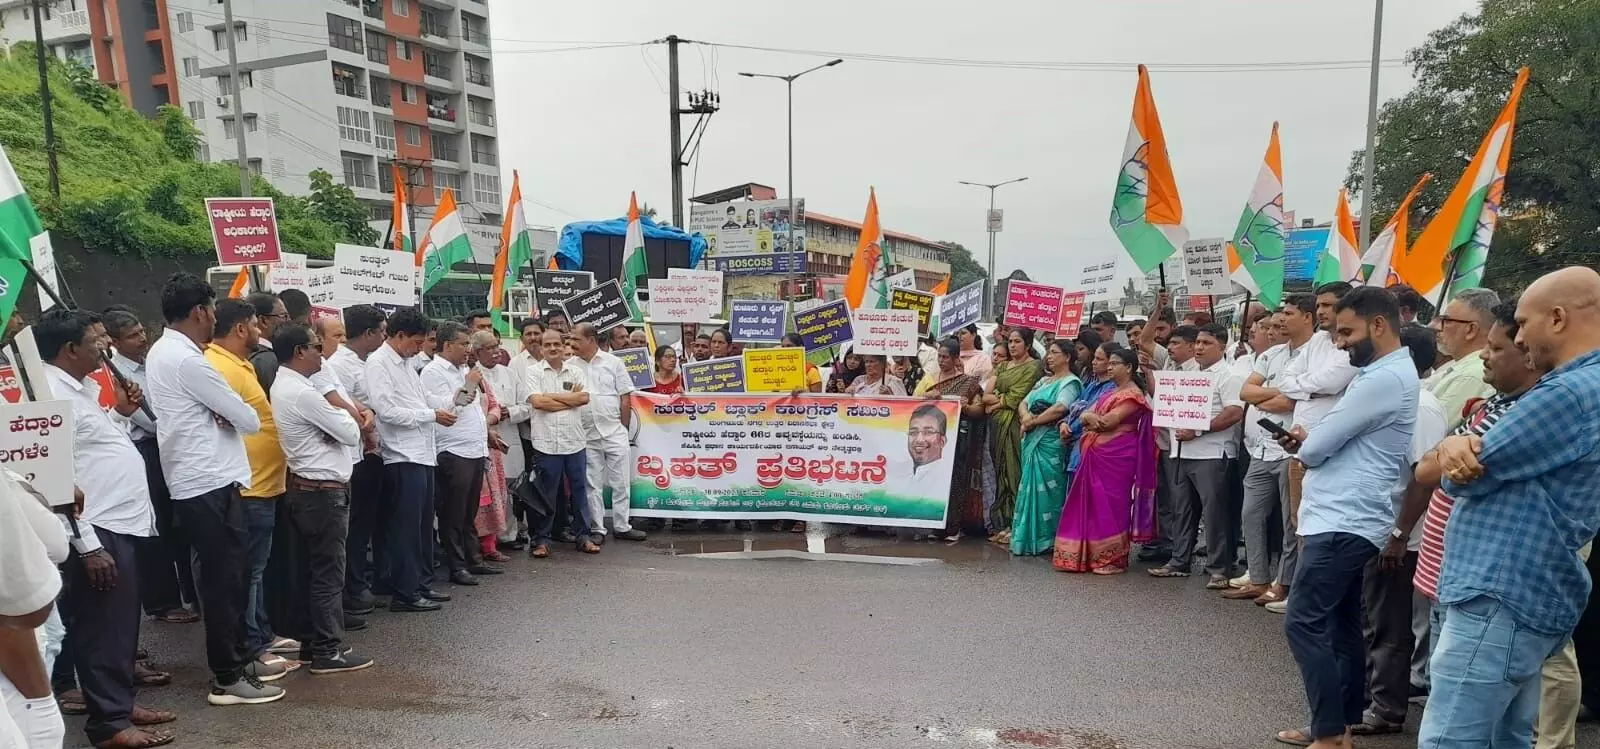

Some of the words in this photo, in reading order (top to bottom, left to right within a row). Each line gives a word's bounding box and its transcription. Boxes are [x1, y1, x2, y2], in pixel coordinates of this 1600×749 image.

[728, 257, 774, 268] BOSCOSS
[654, 402, 716, 421] ಸುರತ್ಕಲ್
[725, 402, 767, 419] ಬ್ಲಾಕ್
[775, 402, 838, 420] ಕಾಂಗ್ರೆಸ್
[846, 404, 891, 417] ಸಮಿತಿ
[10, 415, 63, 437] ಹೆದ್ದಾರಿ
[682, 430, 716, 442] ರಾಷ್ಟ್ರೀಯ
[721, 430, 747, 442] ಹೆದ್ದಾರಿ
[636, 451, 738, 490] ಬೃಹತ್
[756, 452, 888, 489] ಪ್ರತಿಭಟನೆ
